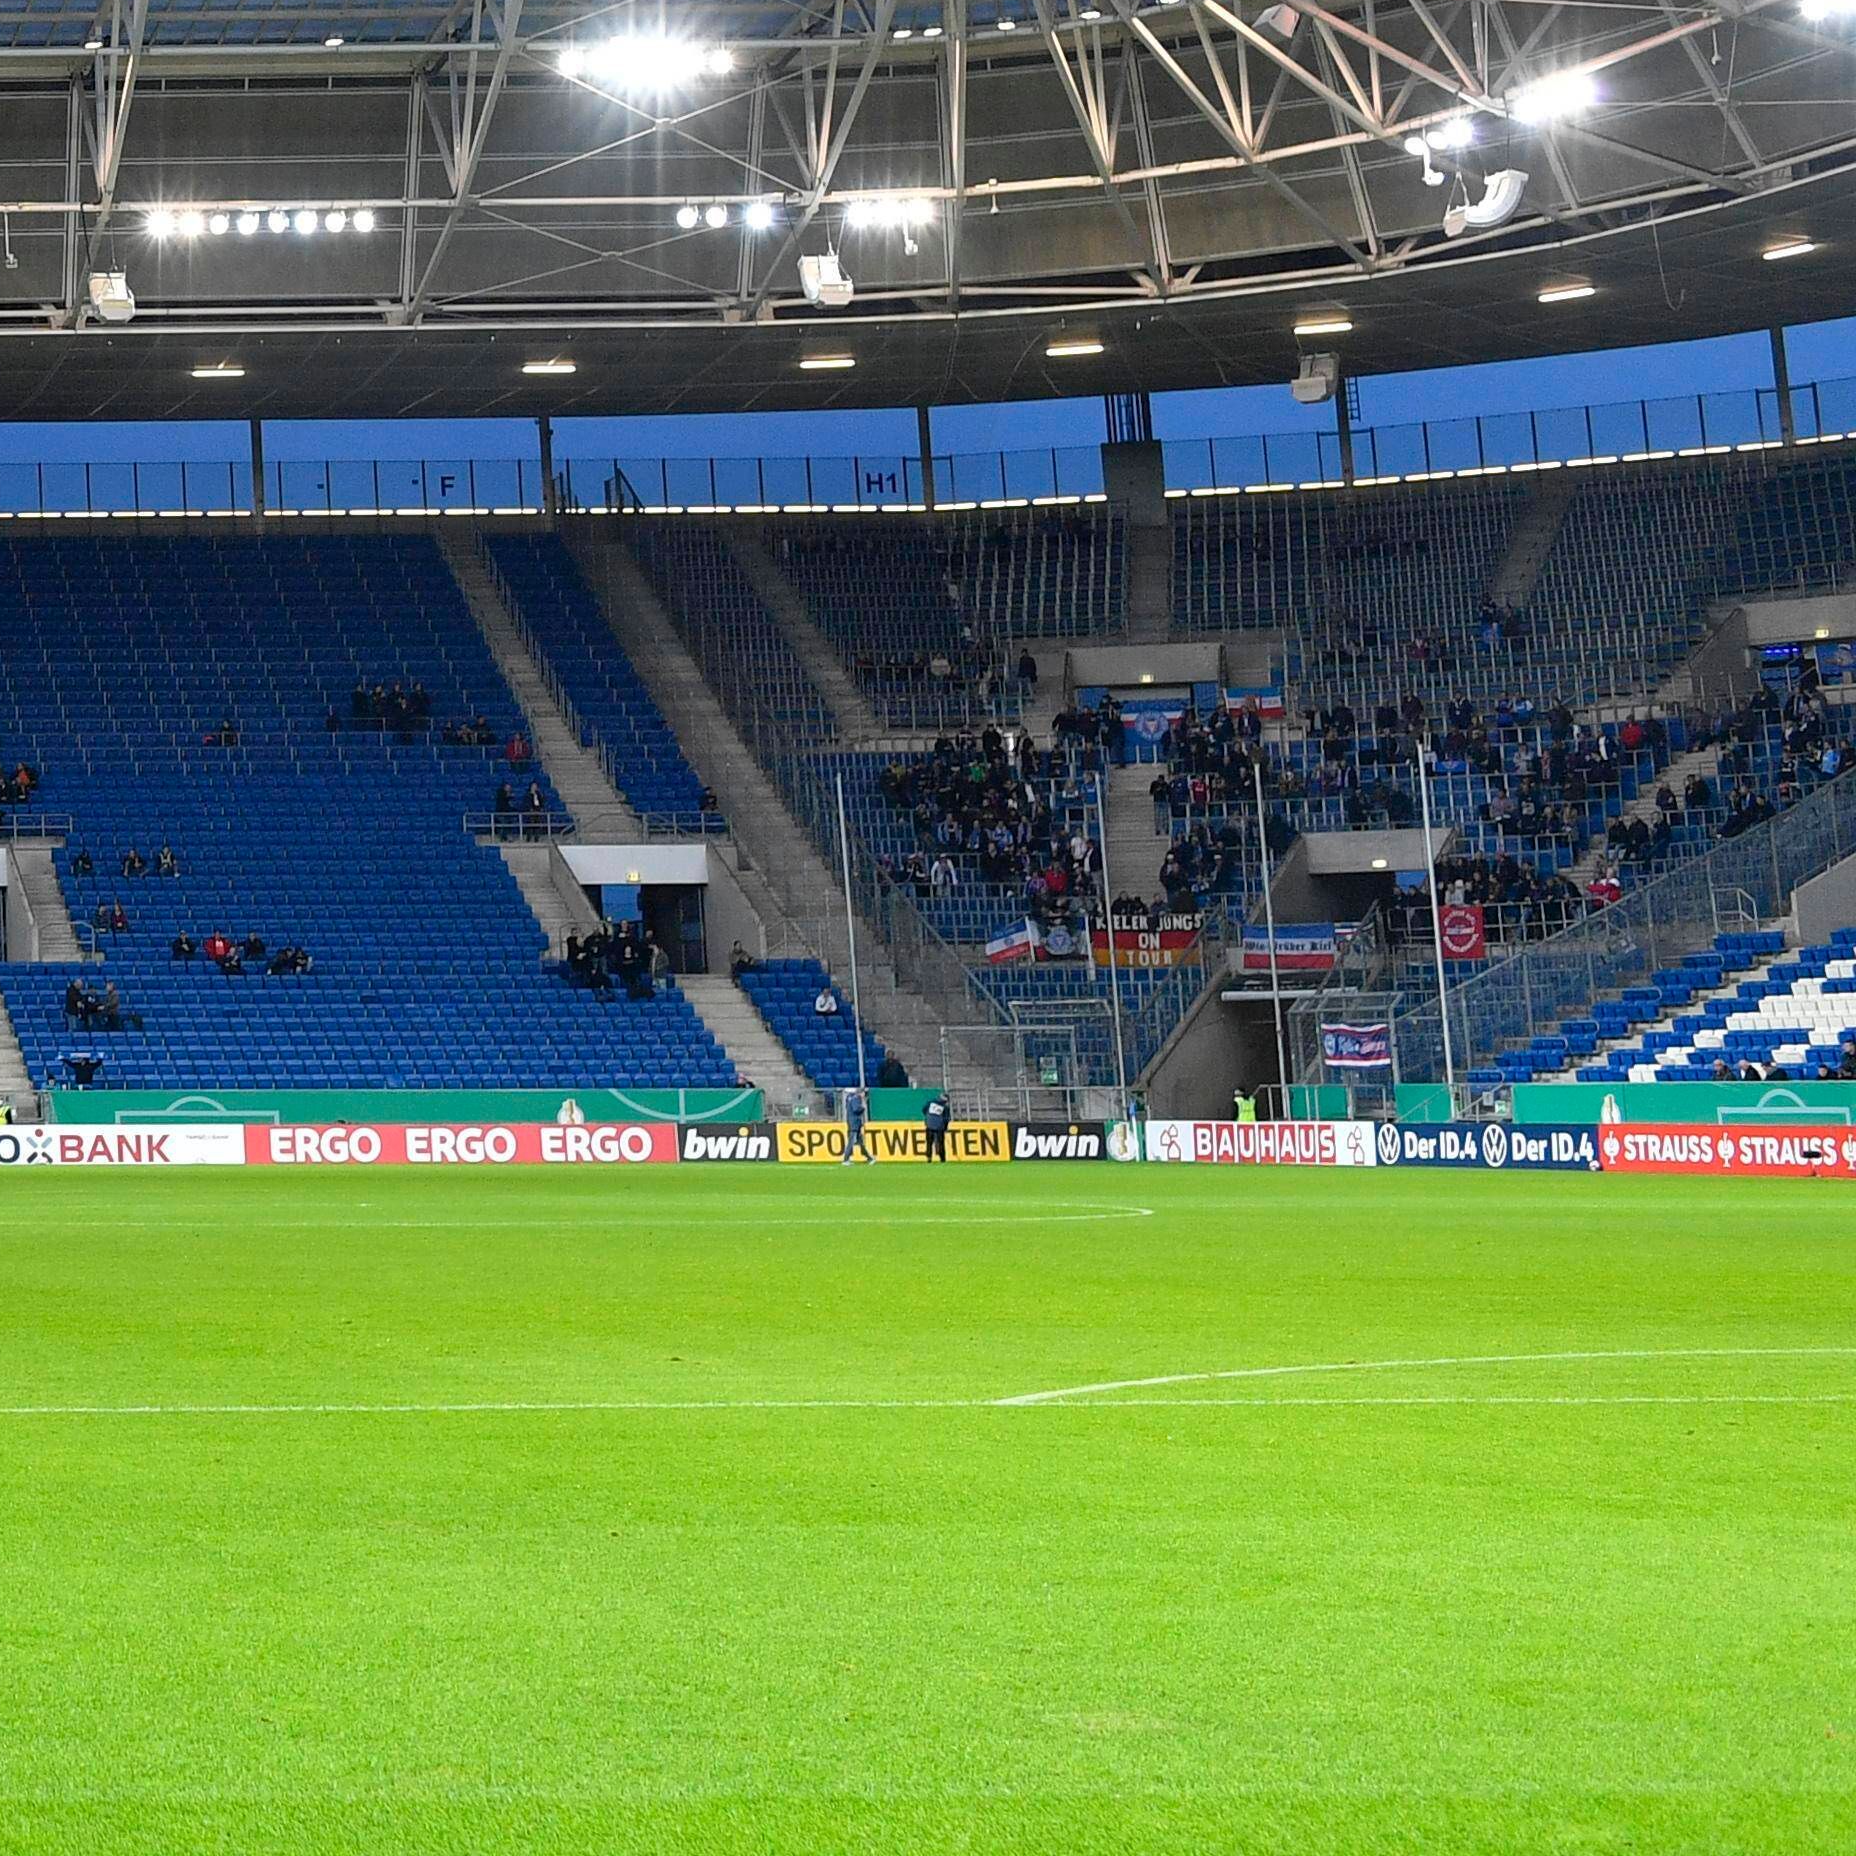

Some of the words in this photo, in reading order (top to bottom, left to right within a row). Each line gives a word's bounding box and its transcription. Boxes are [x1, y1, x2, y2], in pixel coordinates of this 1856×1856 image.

[440, 476, 455, 497] F
[866, 472, 897, 493] H1
[1095, 915, 1148, 930] KELER
[1138, 932, 1160, 949] ON
[1126, 950, 1172, 965] TOUR
[60, 1134, 170, 1162] BANK
[270, 1127, 381, 1163] ERGO
[406, 1128, 517, 1162] ERGO
[540, 1127, 652, 1162] ERGO
[685, 1126, 770, 1159] bwin
[788, 1129, 1000, 1156] SPOTWETEN
[1015, 1126, 1099, 1158] bwin
[1196, 1126, 1334, 1161] BAUHAUS
[1405, 1132, 1437, 1159] Der
[1440, 1132, 1477, 1160] ID.4
[1512, 1133, 1547, 1162] Der
[1550, 1133, 1593, 1163] ID.4
[1624, 1135, 1712, 1162] STRAUSS
[1739, 1137, 1837, 1166] STRAUSS
